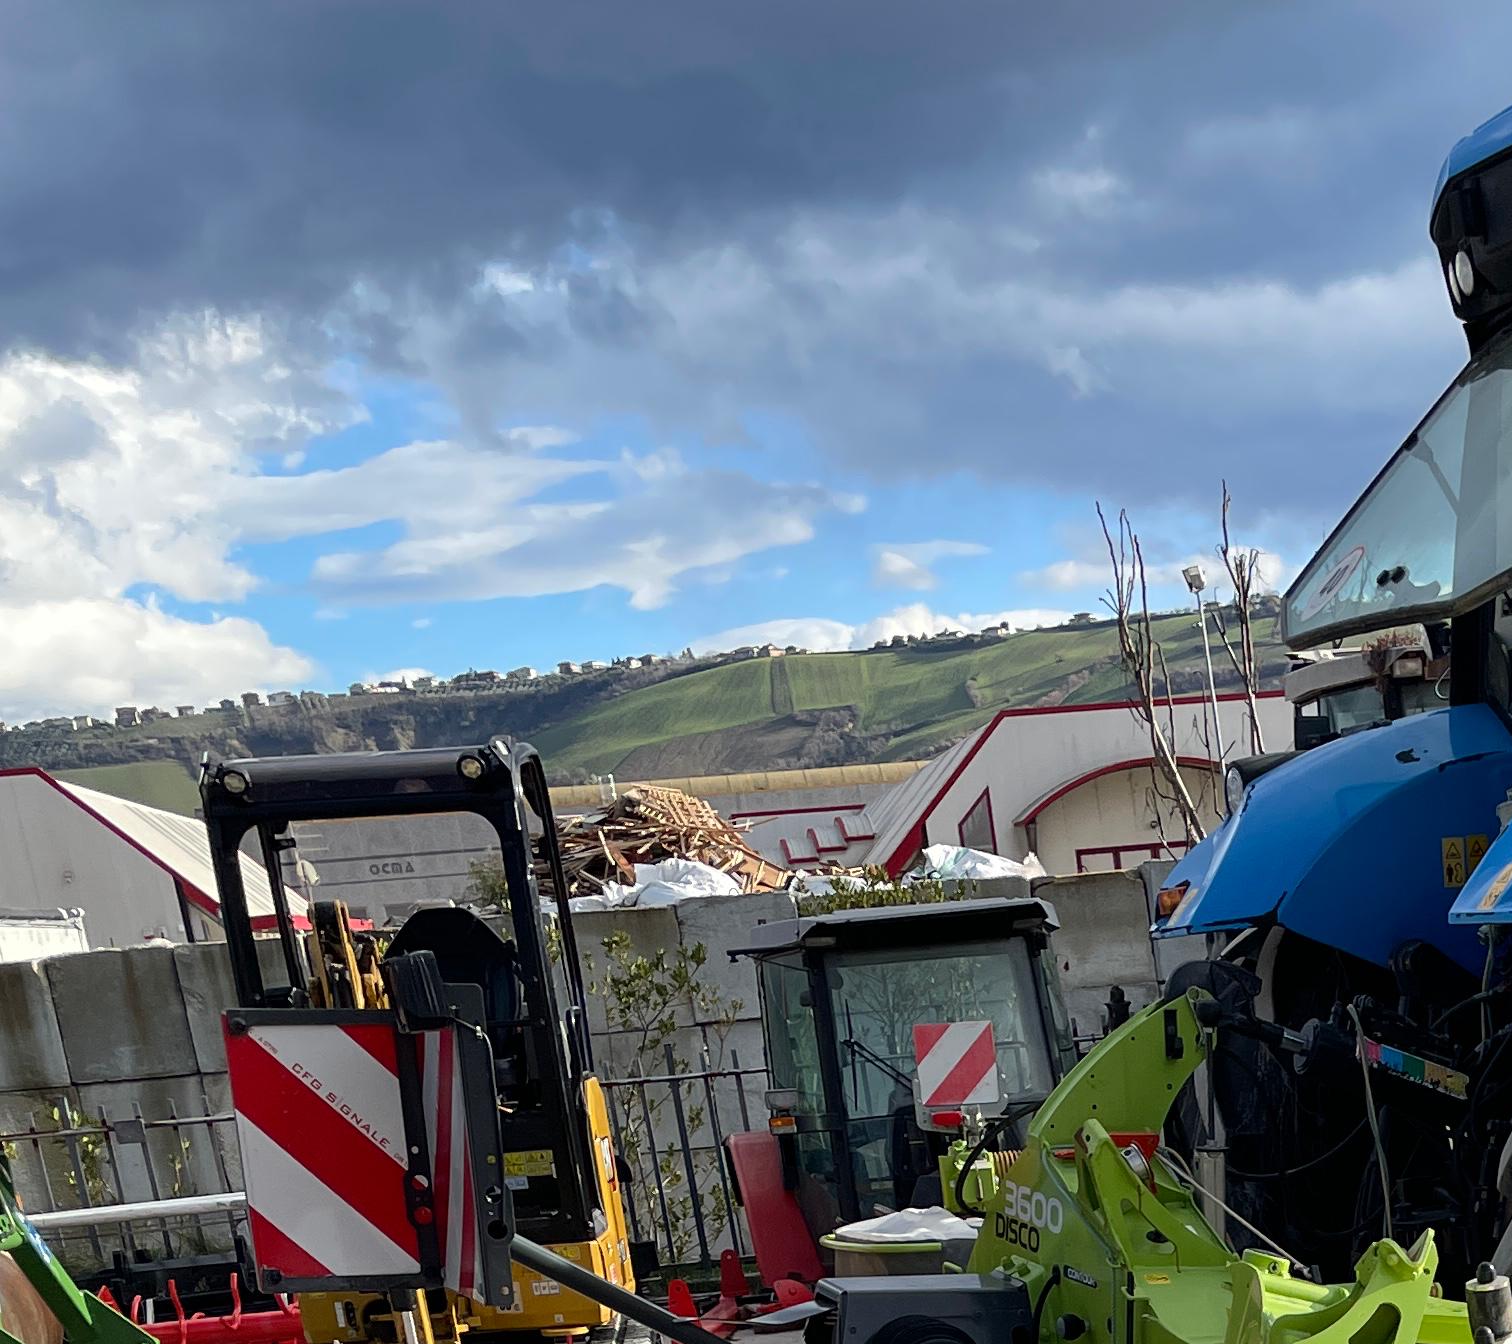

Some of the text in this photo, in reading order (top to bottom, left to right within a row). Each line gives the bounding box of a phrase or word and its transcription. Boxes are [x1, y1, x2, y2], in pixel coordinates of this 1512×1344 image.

[291, 1062, 391, 1150] CFG SIGNALE
[995, 1211, 1040, 1253] DISCO
[1004, 1180, 1063, 1234] 3600
